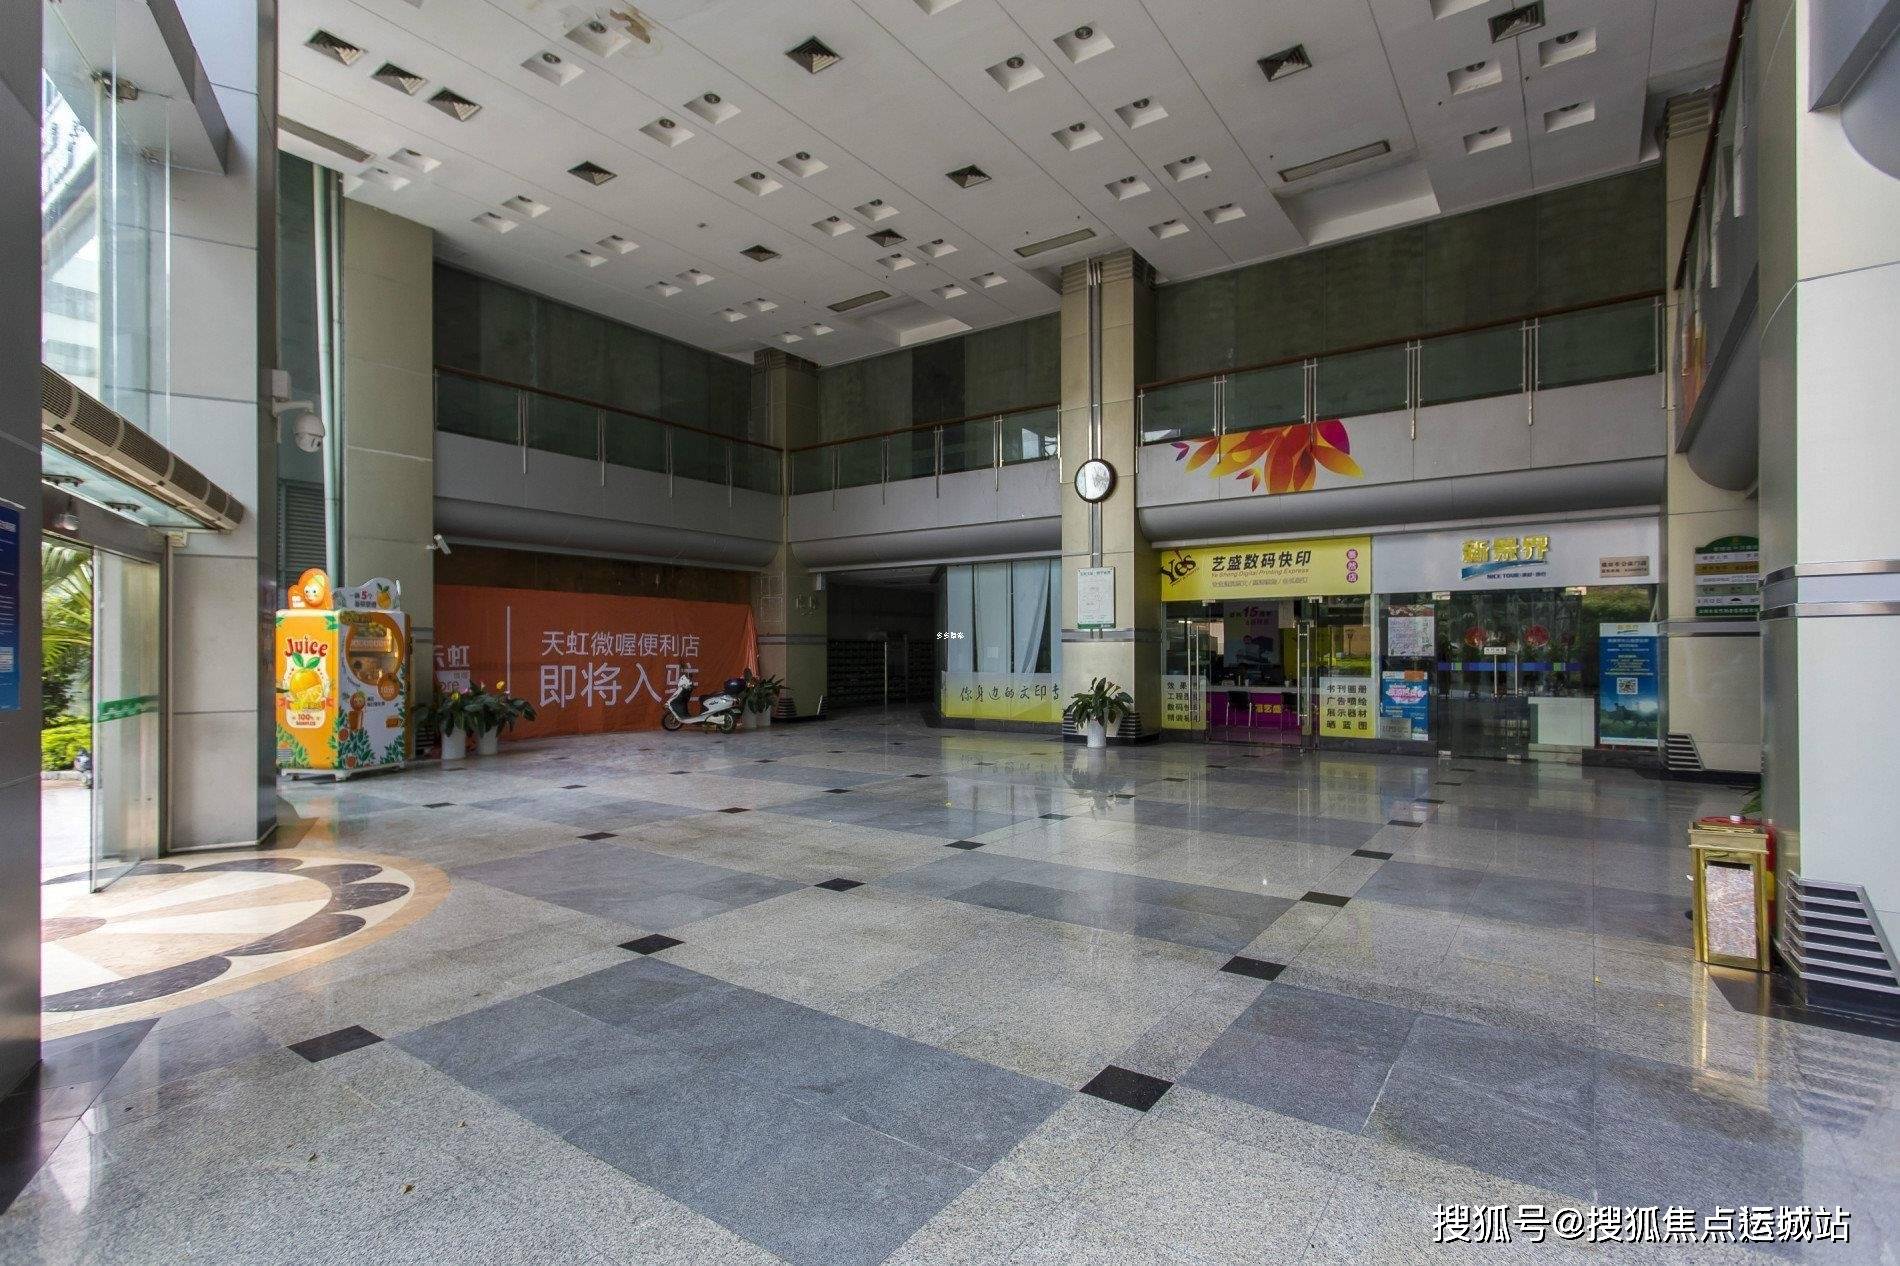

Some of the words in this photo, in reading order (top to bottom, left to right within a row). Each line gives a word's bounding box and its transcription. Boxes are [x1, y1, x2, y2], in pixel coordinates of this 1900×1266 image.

[1211, 550, 1311, 572] 艺盛数码快印
[284, 636, 329, 657] Juice
[541, 630, 700, 658] 天虹微喔便利店
[1326, 697, 1367, 706] 广告喷绘
